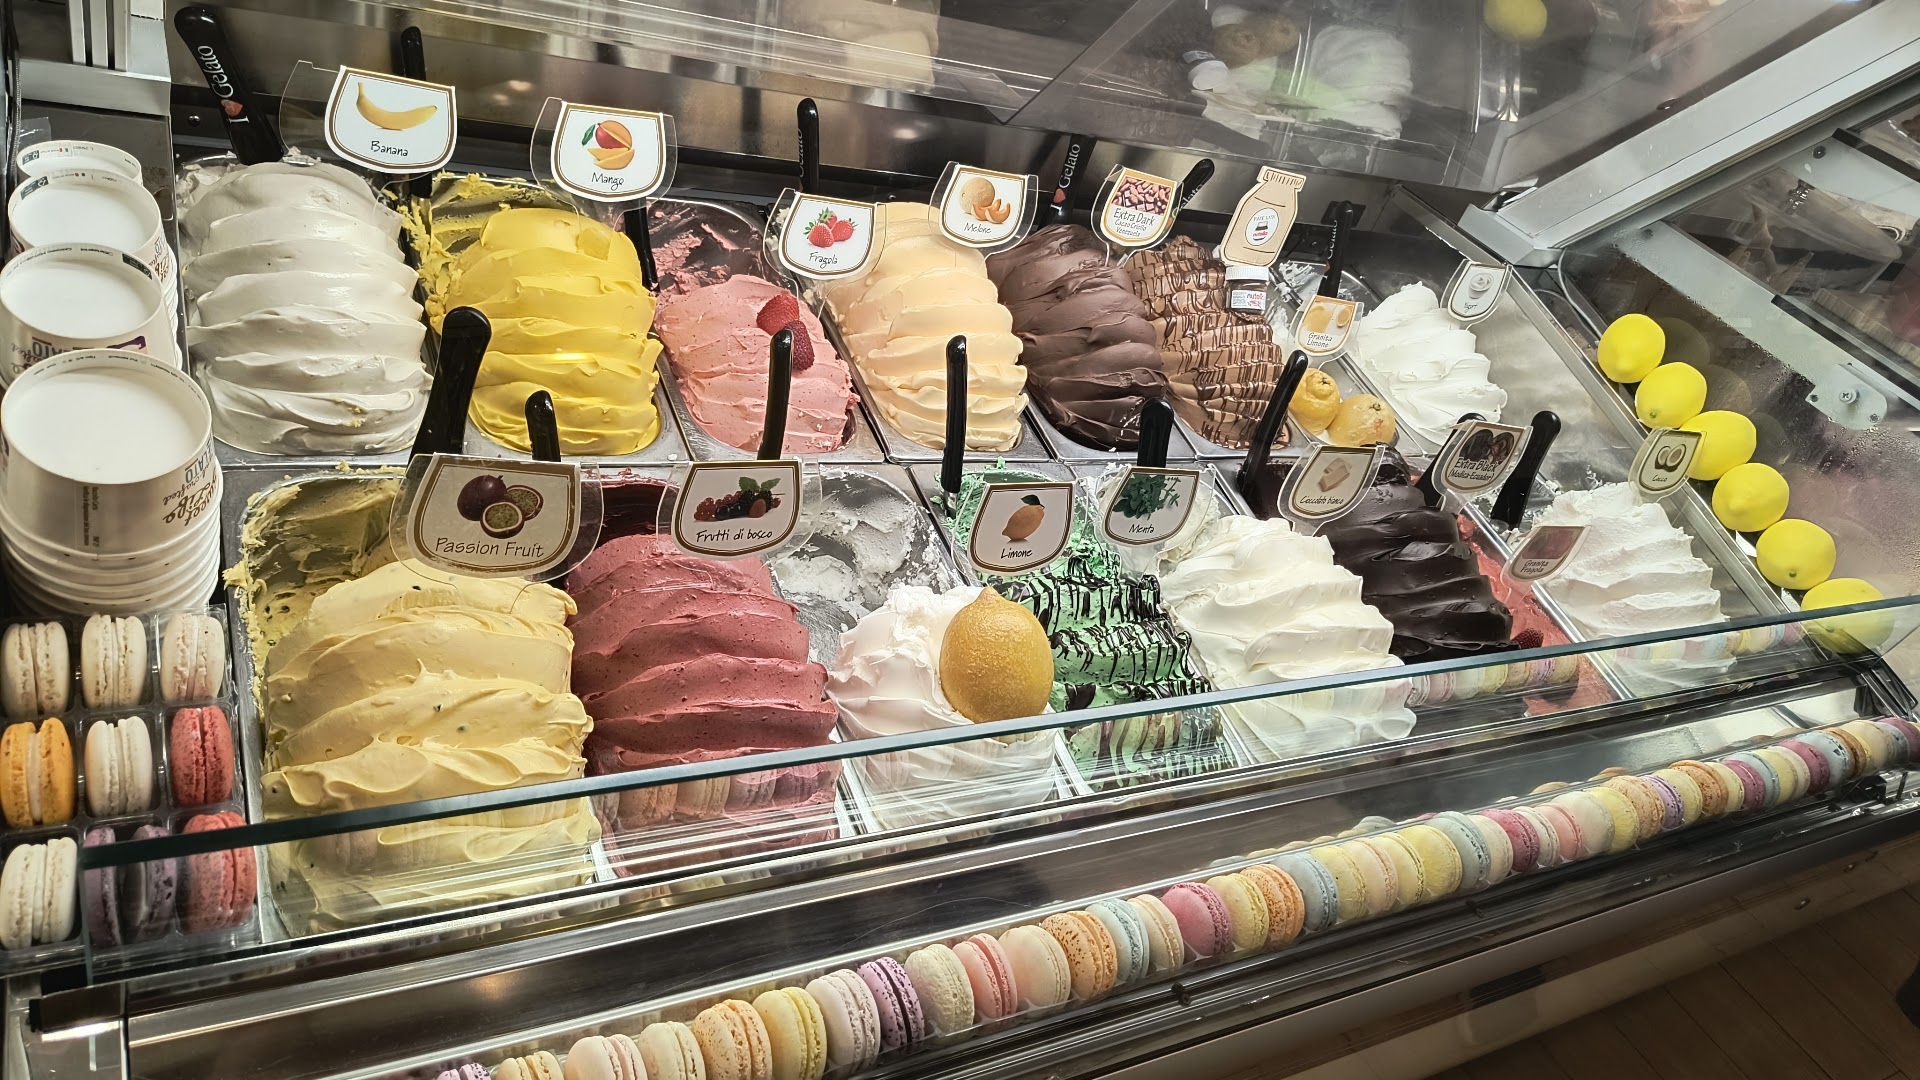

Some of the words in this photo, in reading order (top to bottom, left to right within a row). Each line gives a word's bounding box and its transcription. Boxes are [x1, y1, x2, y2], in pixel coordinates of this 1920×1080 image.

[197, 45, 234, 98] Gelato
[370, 140, 409, 157] Banana
[1058, 143, 1081, 189] Gelato
[591, 171, 625, 191] Mango
[1113, 207, 1135, 222] Extra
[1136, 212, 1156, 227] Dark
[1114, 218, 1131, 229] Cacao
[963, 222, 993, 235] Melone
[1116, 226, 1141, 238] Venezuela
[808, 251, 839, 270] Fragola
[1306, 339, 1329, 348] Limone
[1308, 332, 1333, 342] Granita
[1454, 457, 1477, 470] Extra
[1475, 459, 1501, 473] Black
[695, 528, 730, 542] Frutti
[733, 528, 744, 541] di
[746, 528, 773, 540] bosco
[1128, 523, 1155, 534] Menta
[435, 537, 499, 556] Passion
[504, 541, 545, 558] Fruit
[1000, 547, 1033, 560] Limone
[1520, 566, 1545, 575] Fragola
